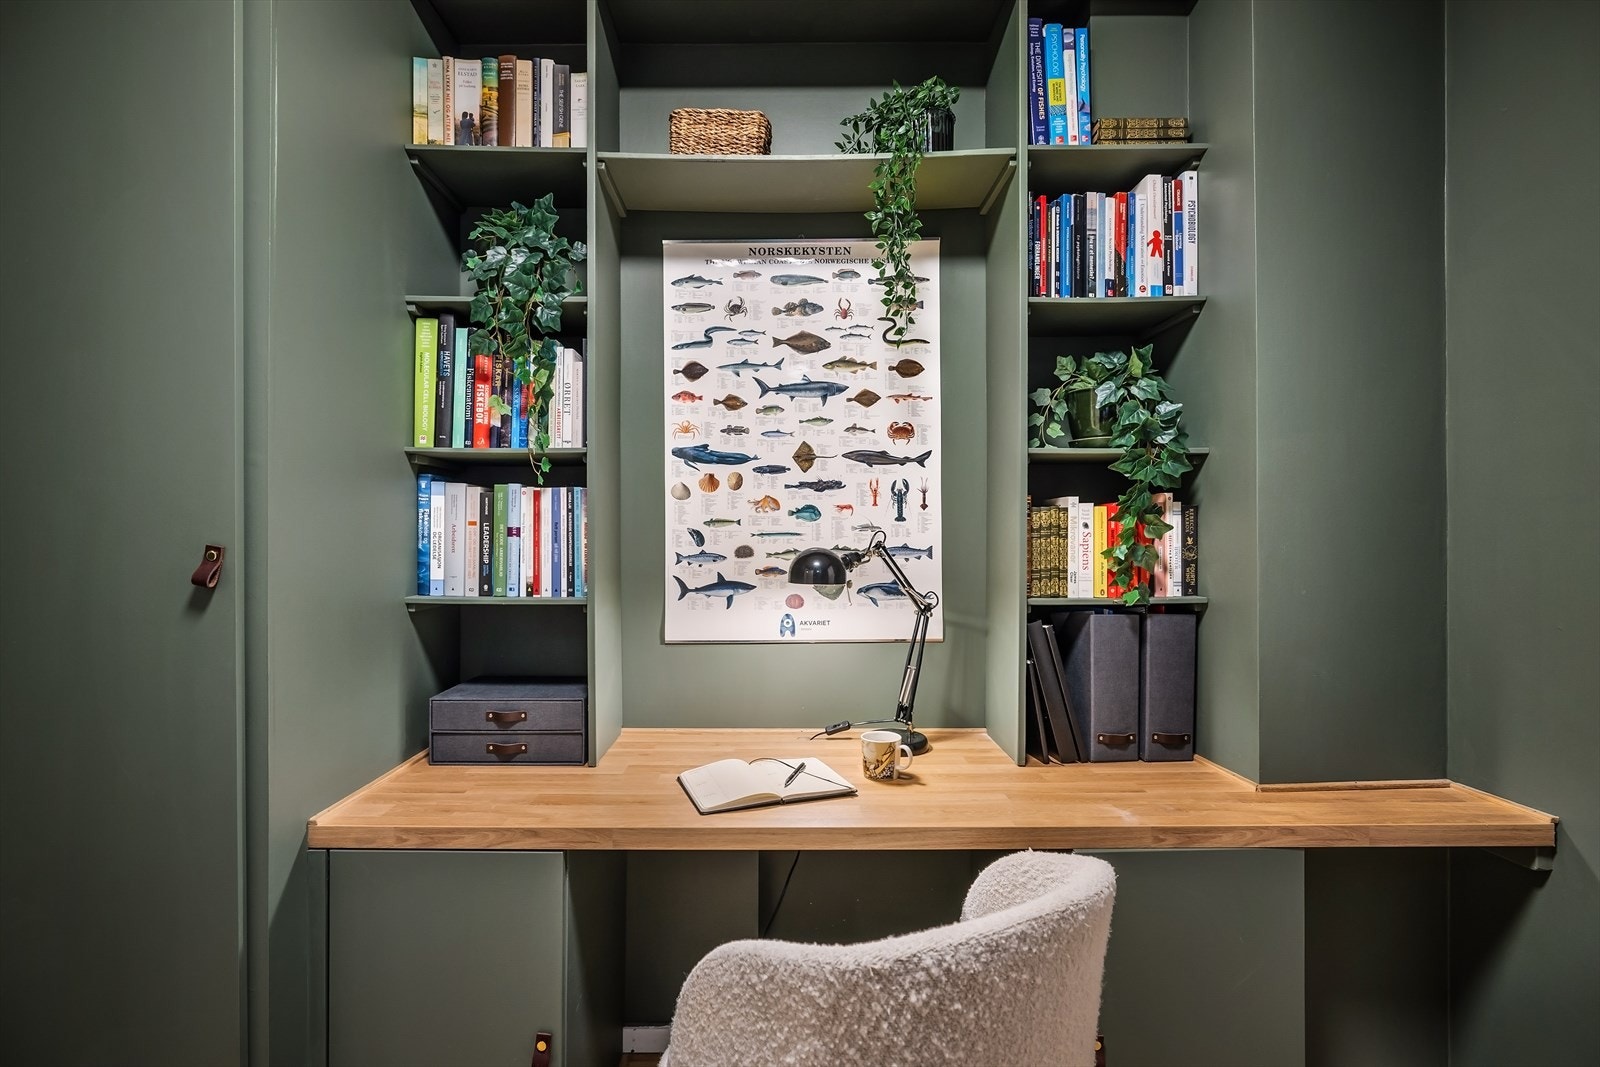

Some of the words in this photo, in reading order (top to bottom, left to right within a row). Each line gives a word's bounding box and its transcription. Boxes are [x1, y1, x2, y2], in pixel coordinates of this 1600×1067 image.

[445, 104, 450, 112] OG
[1038, 88, 1043, 96] OF
[748, 247, 852, 256] NORSKEKYSTEN
[466, 368, 475, 420] Fiskeanatomi
[476, 384, 484, 424] FISKEBOK
[1070, 516, 1078, 563] Mikrovaner
[1080, 531, 1092, 570] Sapiens
